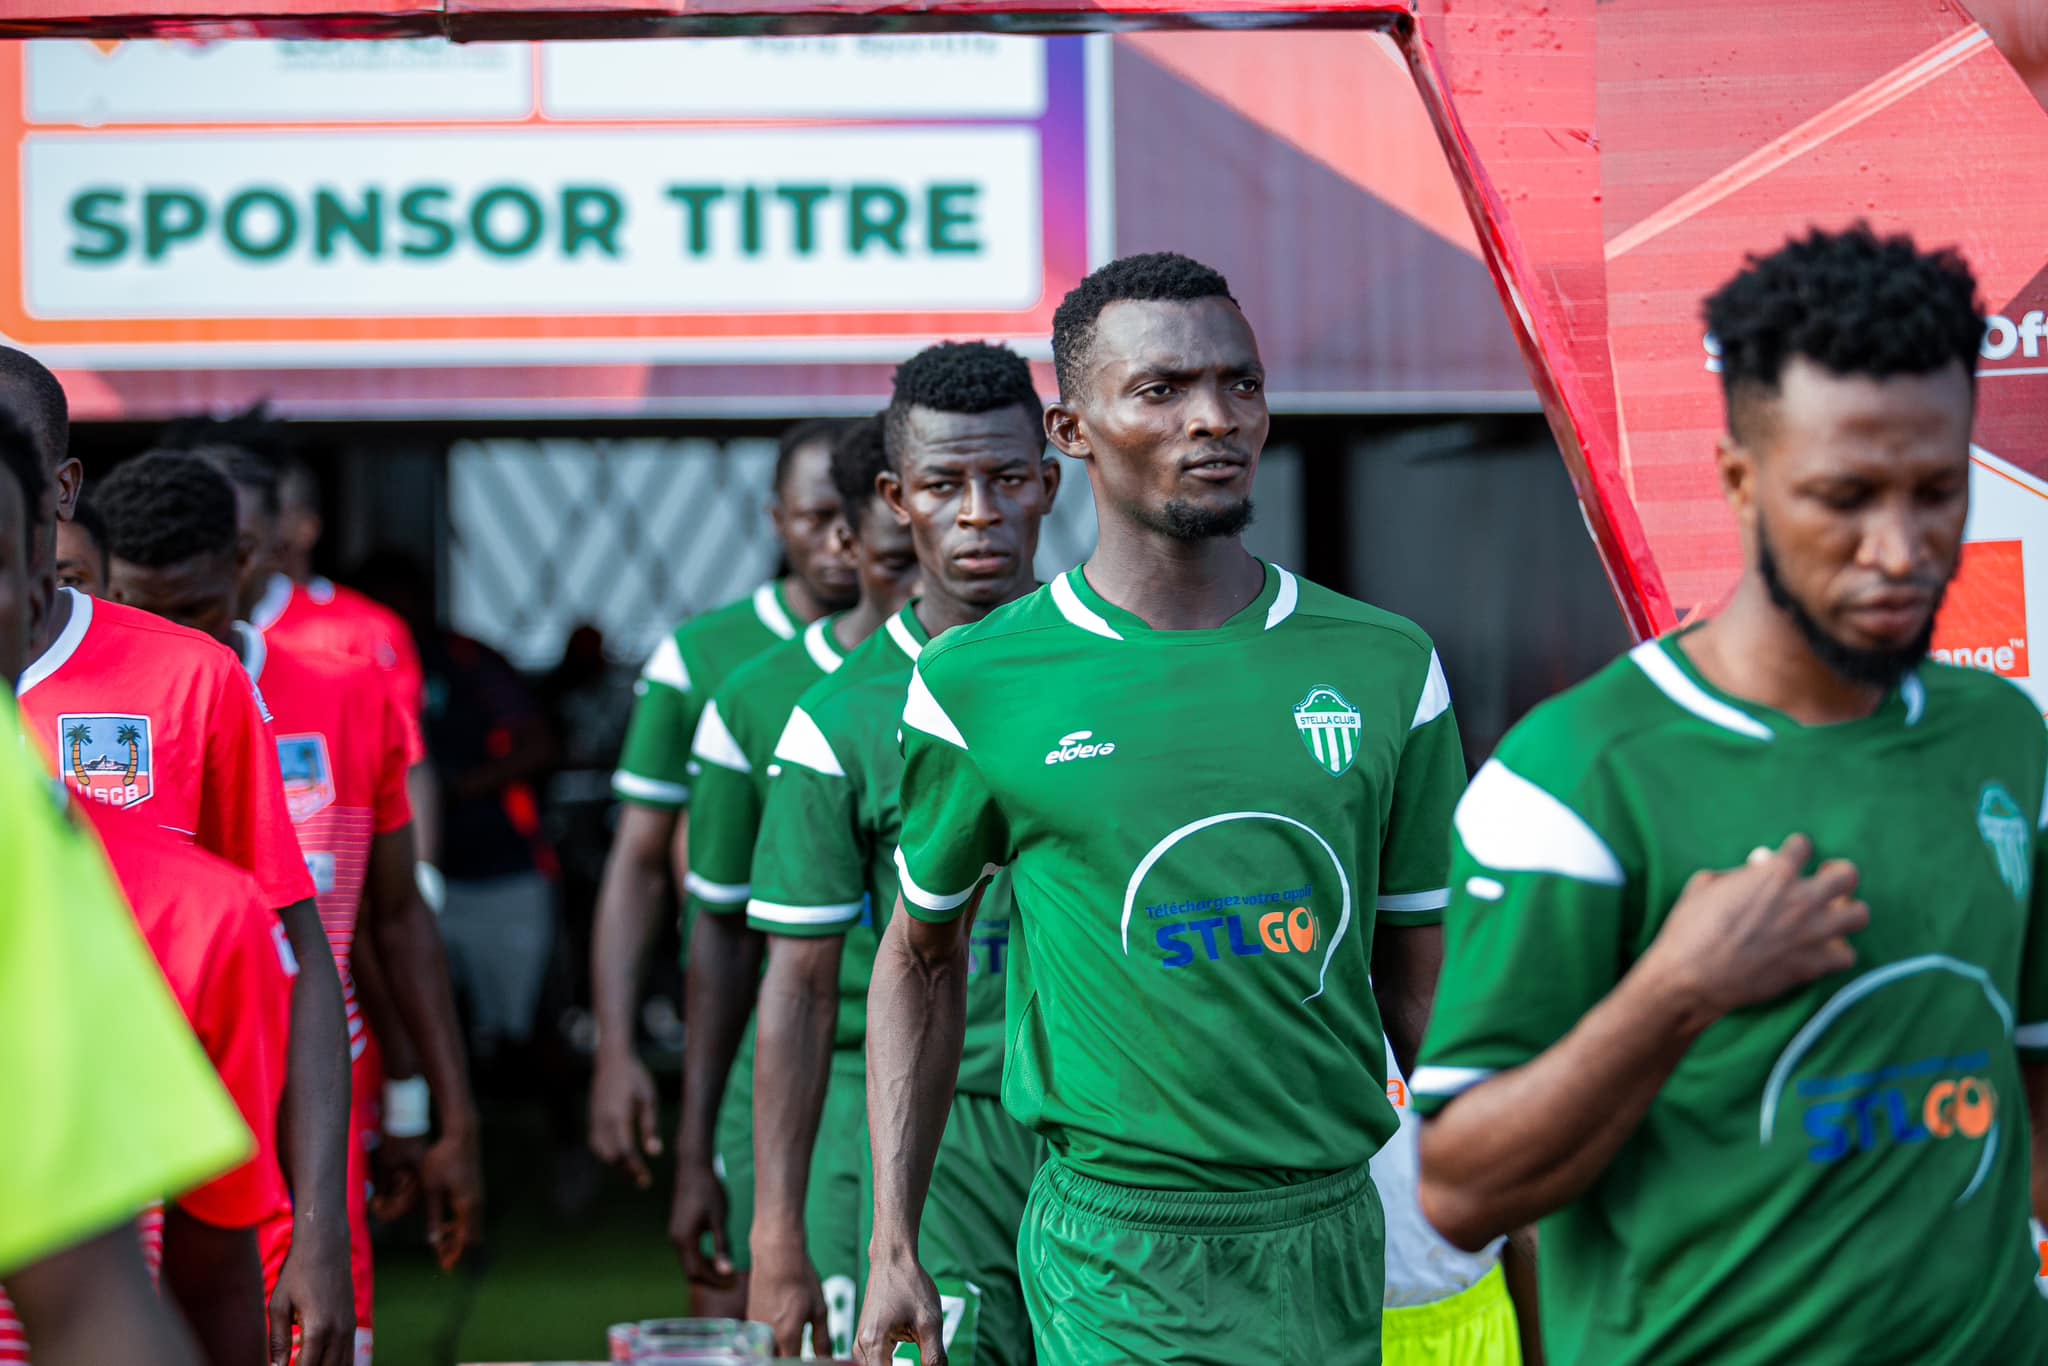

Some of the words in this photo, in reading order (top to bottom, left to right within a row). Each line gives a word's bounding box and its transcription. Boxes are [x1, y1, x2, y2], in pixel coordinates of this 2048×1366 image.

[68, 183, 627, 264] SPONSOR
[666, 181, 984, 256] TITRE
[1300, 715, 1333, 725] STELLA
[1333, 715, 1356, 725] CLUB
[1045, 742, 1116, 765] eldera
[1145, 895, 1241, 920] Téléchargez
[1244, 890, 1281, 907] votre
[1283, 883, 1313, 904] appli
